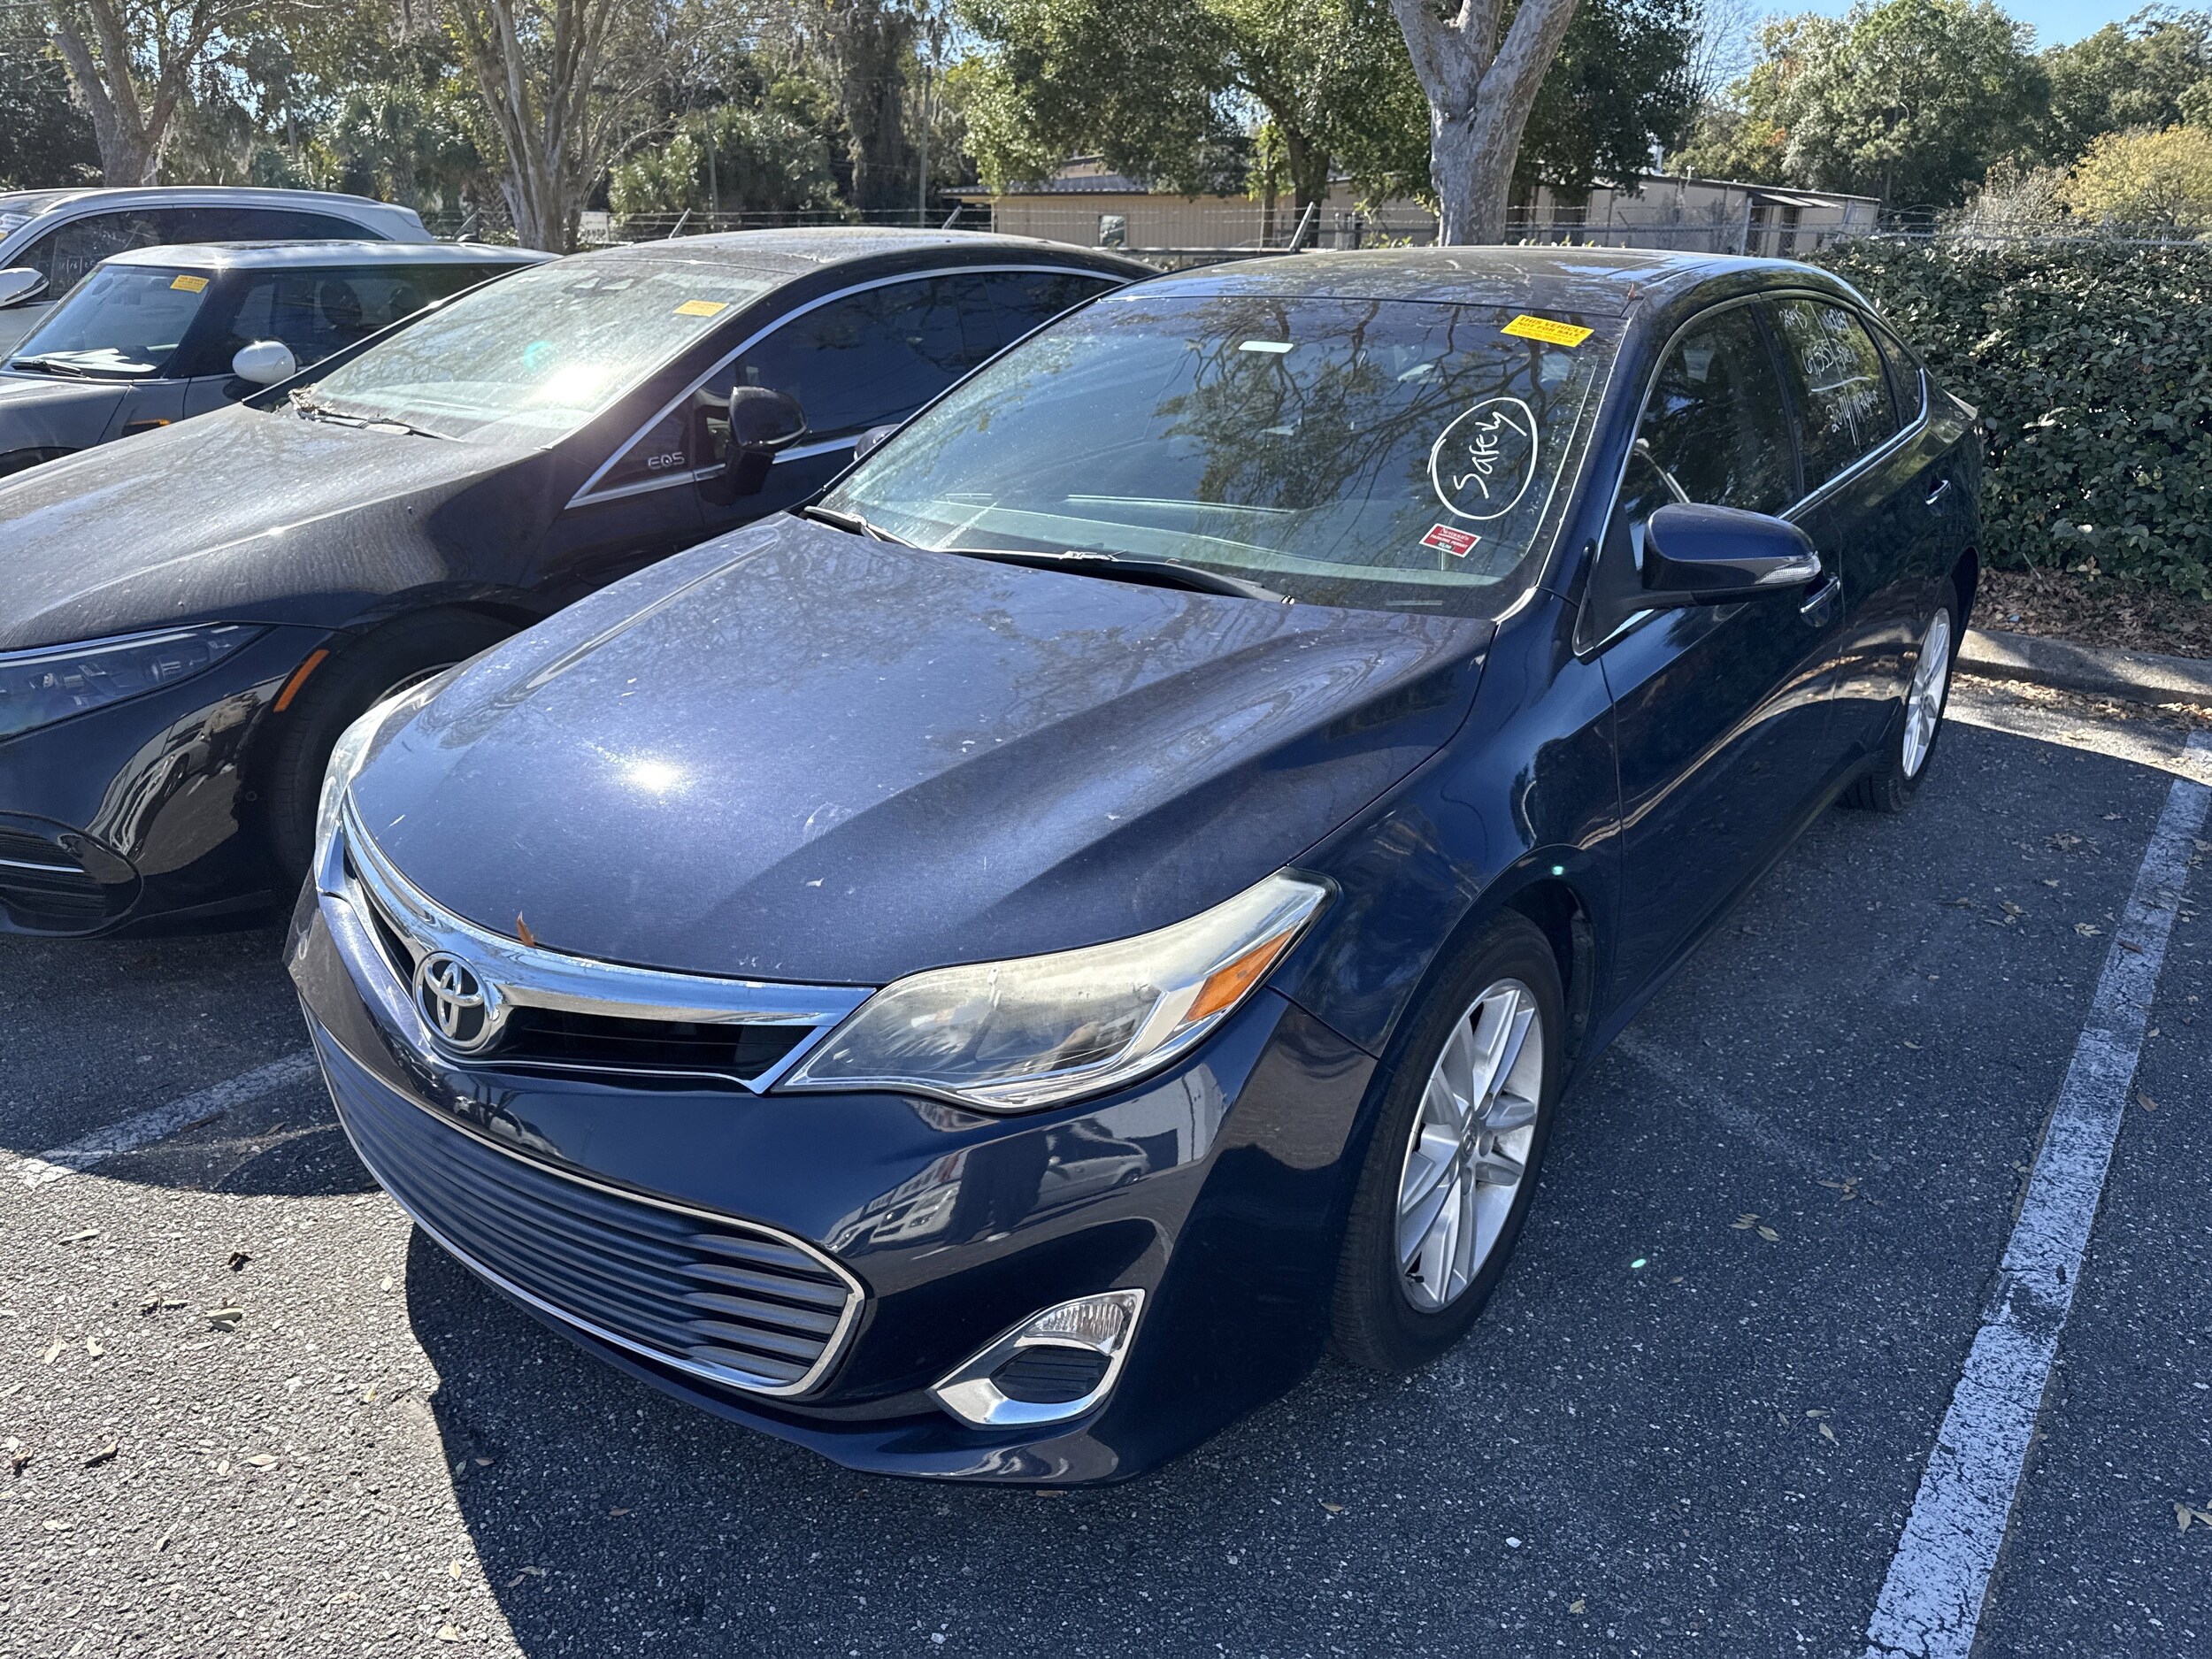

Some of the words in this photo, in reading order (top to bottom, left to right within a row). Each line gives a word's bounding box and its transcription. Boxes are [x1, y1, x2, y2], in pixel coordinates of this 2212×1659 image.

[1519, 316, 1543, 326] THIS
[1545, 321, 1586, 334] VEHICLE
[648, 451, 685, 470] EQS
[1430, 534, 1451, 543] PARKING
[1450, 539, 1469, 549] PERMIT
